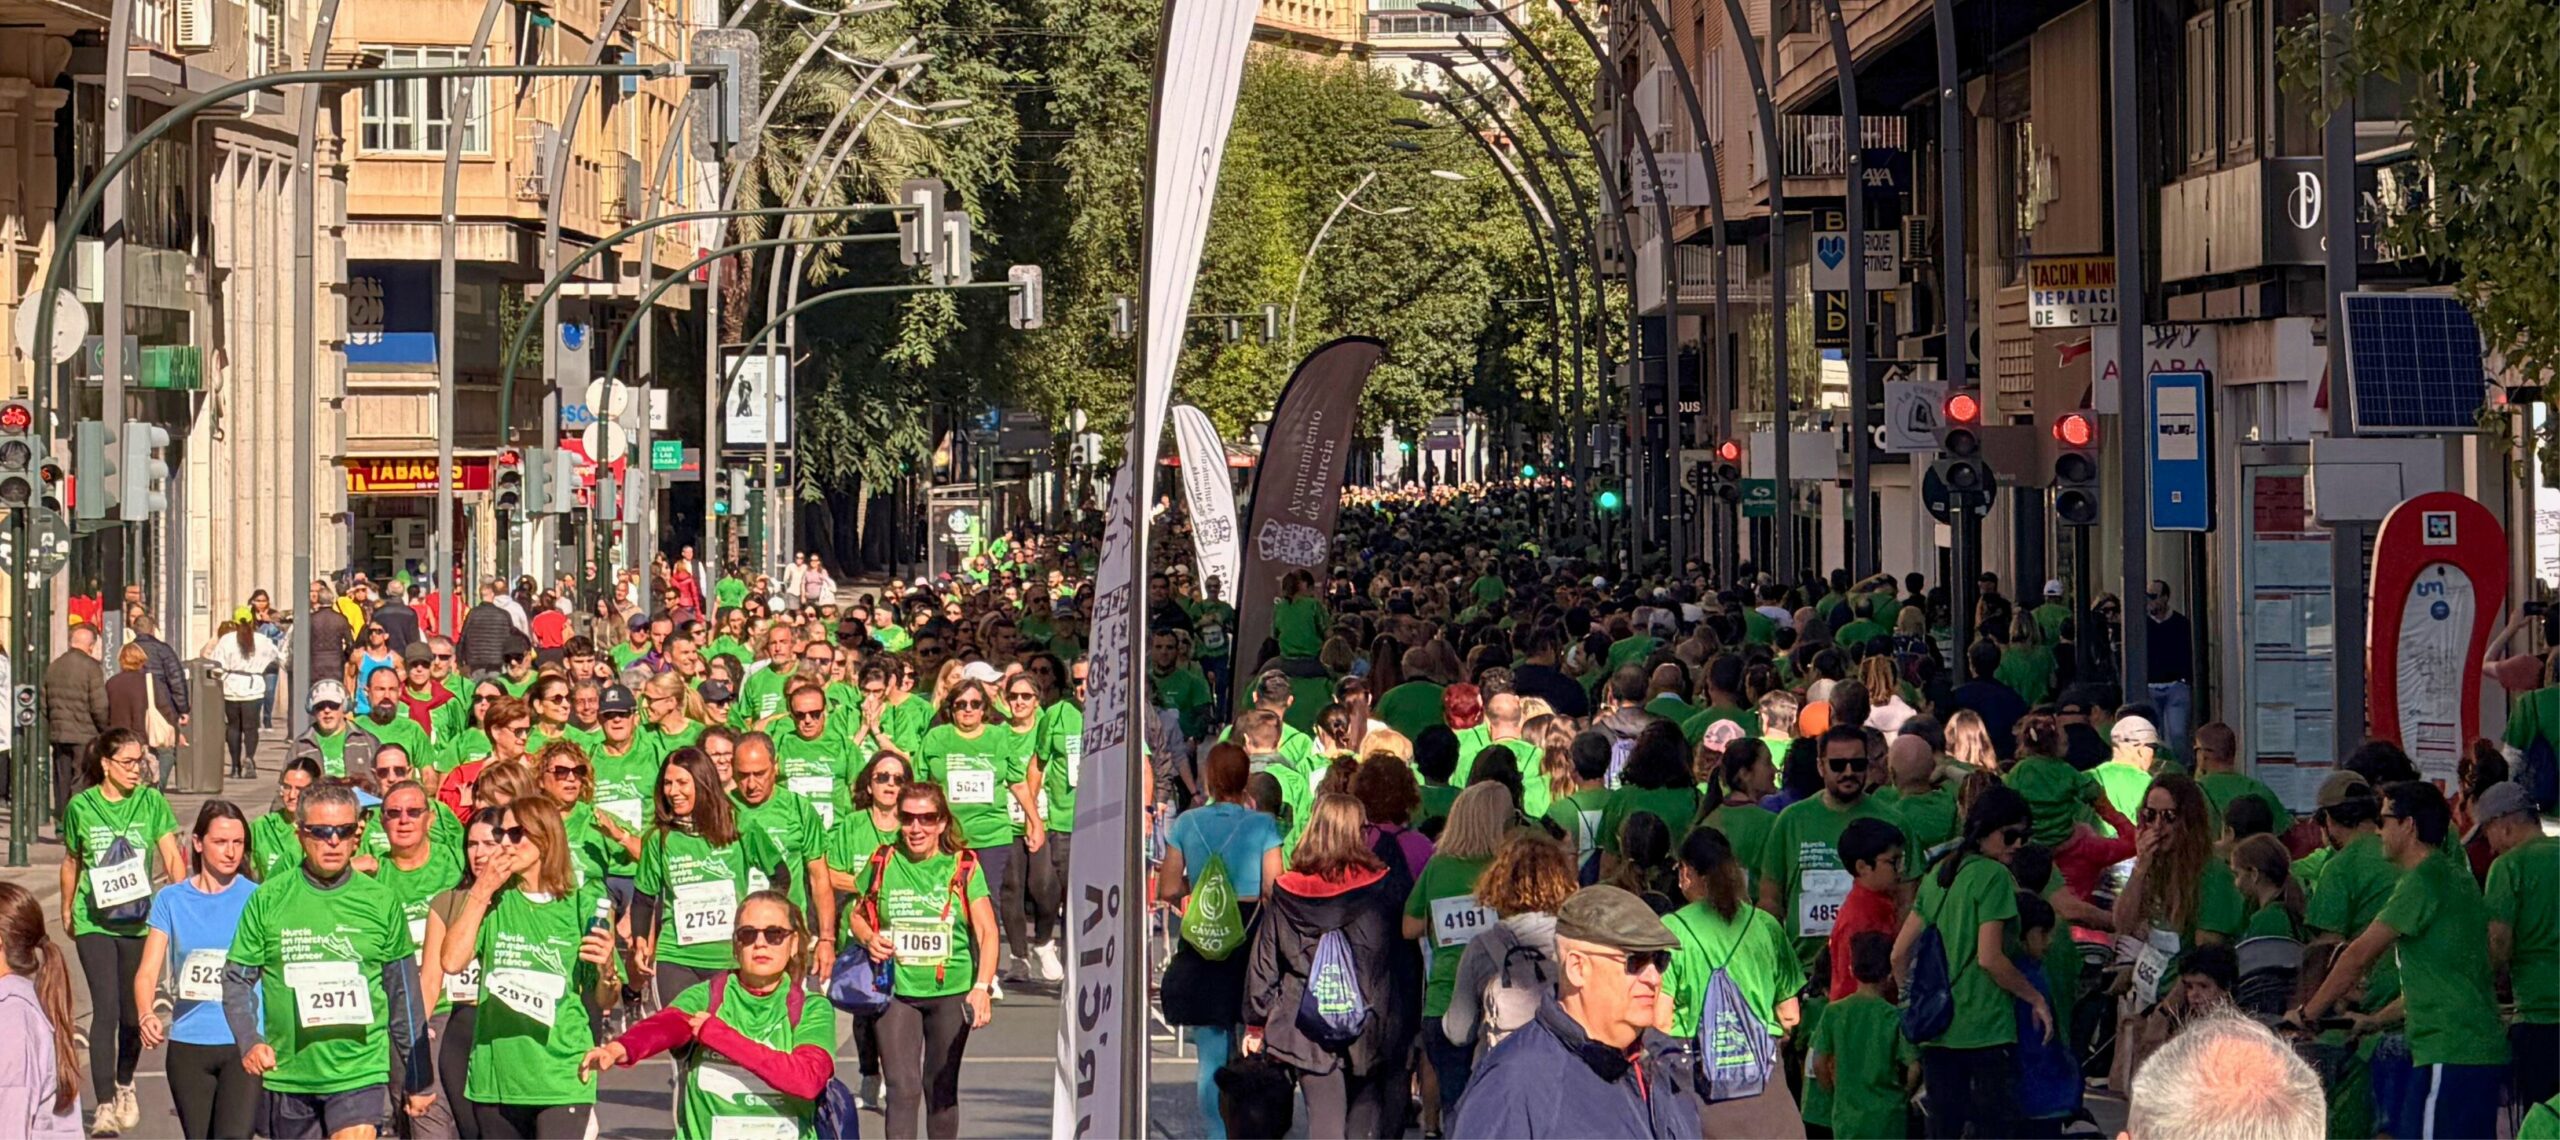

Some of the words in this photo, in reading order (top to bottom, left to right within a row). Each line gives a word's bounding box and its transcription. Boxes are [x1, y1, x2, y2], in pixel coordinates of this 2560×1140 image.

[1862, 167, 1894, 186] AXA
[1865, 233, 1891, 251] RIQUE
[1865, 255, 1894, 272] RTINEZ
[2032, 263, 2079, 287] TACON
[2035, 289, 2116, 306] REPARACI
[2035, 310, 2054, 326] DE
[369, 459, 464, 481] TABACS
[1288, 410, 1323, 517] Ayuntamiento
[1309, 439, 1336, 498] Murcia
[1304, 500, 1321, 521] de
[102, 872, 139, 894] 2303
[685, 908, 727, 929] 2752
[1444, 907, 1486, 930] 4191
[1809, 903, 1840, 921] 485
[901, 933, 942, 951] 1069
[191, 965, 223, 984] 523
[459, 968, 480, 986] 52
[310, 989, 358, 1009] 2971
[497, 985, 544, 1009] 2970
